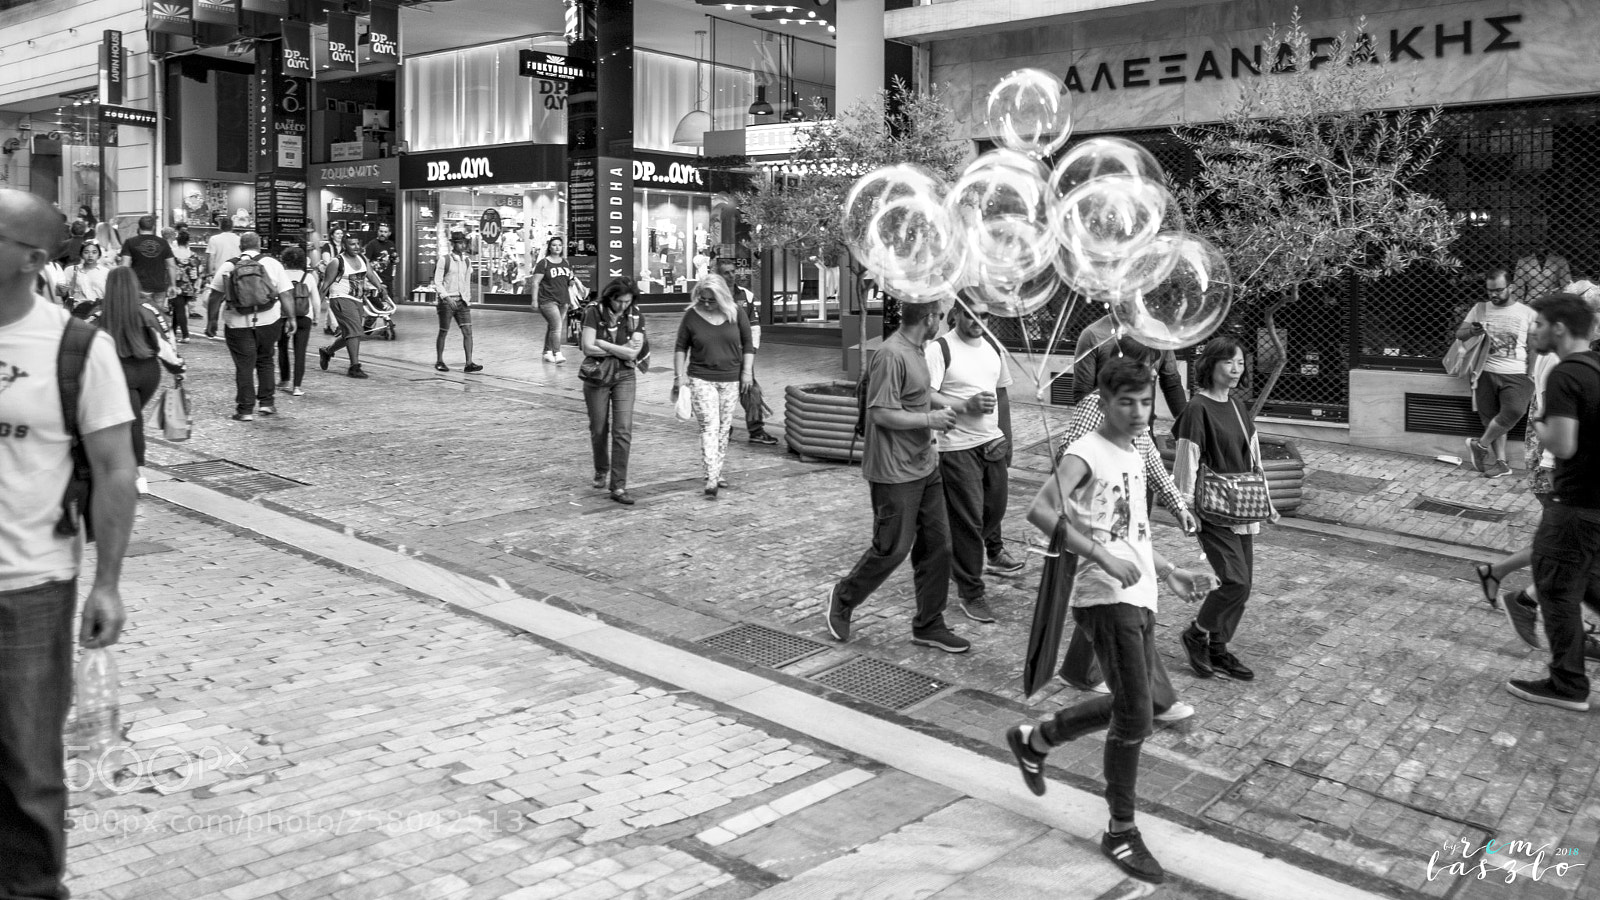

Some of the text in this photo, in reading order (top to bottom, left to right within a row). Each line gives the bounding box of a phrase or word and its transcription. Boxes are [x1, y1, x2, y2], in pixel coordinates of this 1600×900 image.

[373, 42, 397, 55] am
[111, 32, 120, 83] LAPIN HOUSE
[332, 51, 354, 63] am
[287, 58, 309, 70] am
